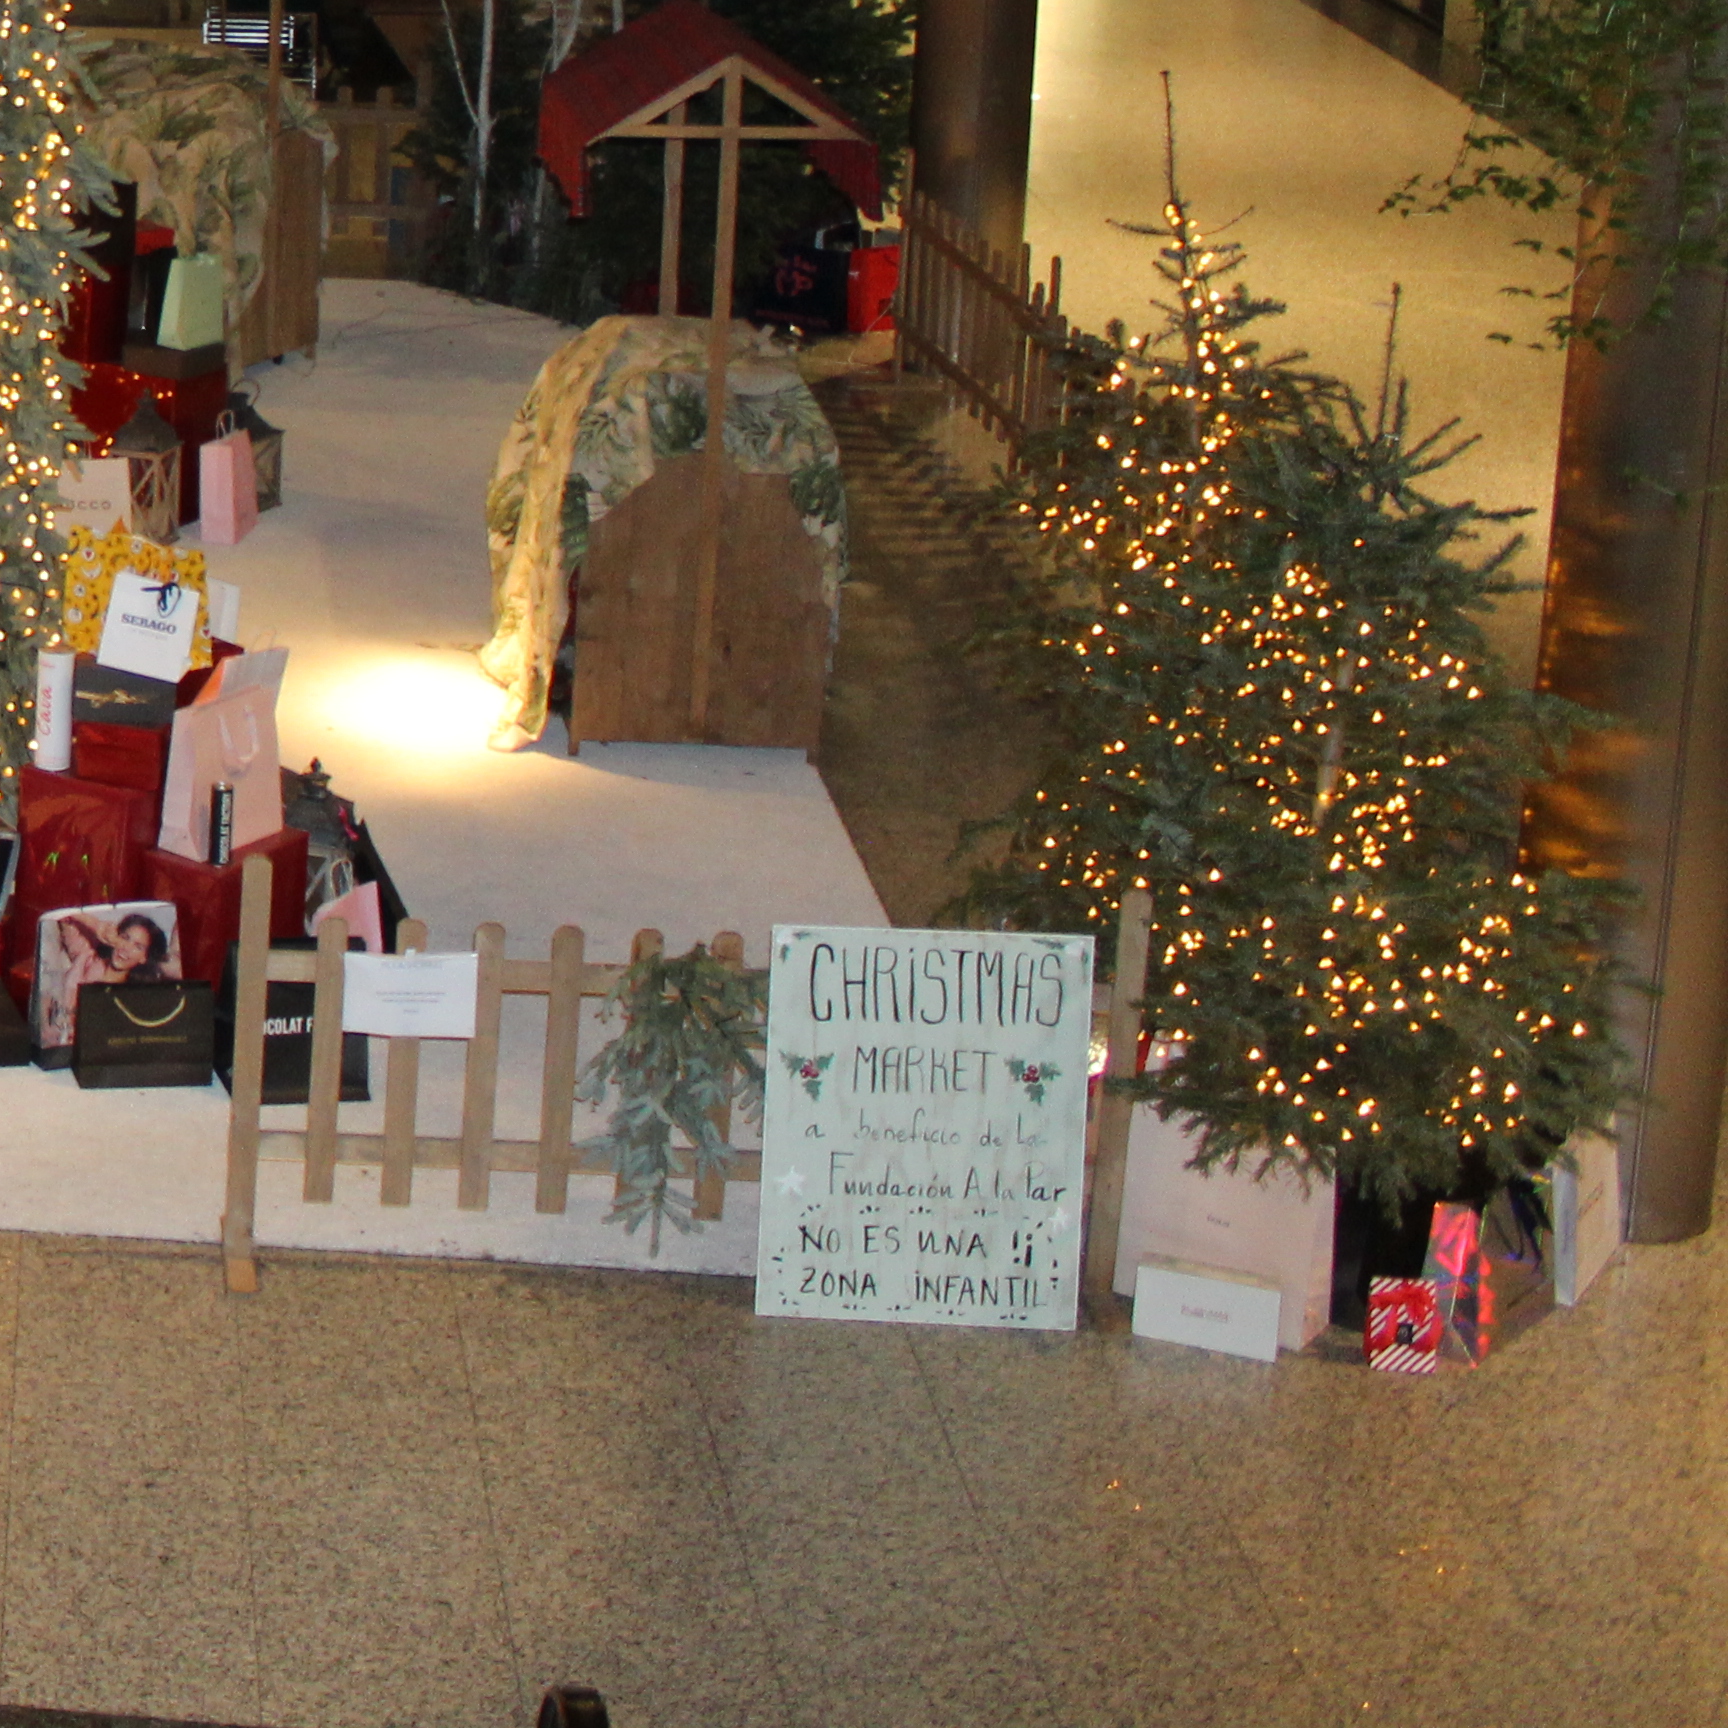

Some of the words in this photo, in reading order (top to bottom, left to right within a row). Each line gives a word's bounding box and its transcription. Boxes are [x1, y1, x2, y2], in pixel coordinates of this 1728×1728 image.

[120, 612, 178, 636] SEBAGO
[852, 1046, 998, 1095] MARKET
[804, 1123, 827, 1140] a
[853, 1107, 961, 1147] beneficio
[978, 1120, 1004, 1148] de
[829, 1151, 955, 1199] Fundación
[962, 1165, 983, 1201] A
[1026, 1160, 1069, 1203] Par
[797, 1224, 842, 1254] NO
[863, 1224, 902, 1255] ES
[917, 1228, 989, 1260] UNA
[799, 1266, 879, 1299] ZONA
